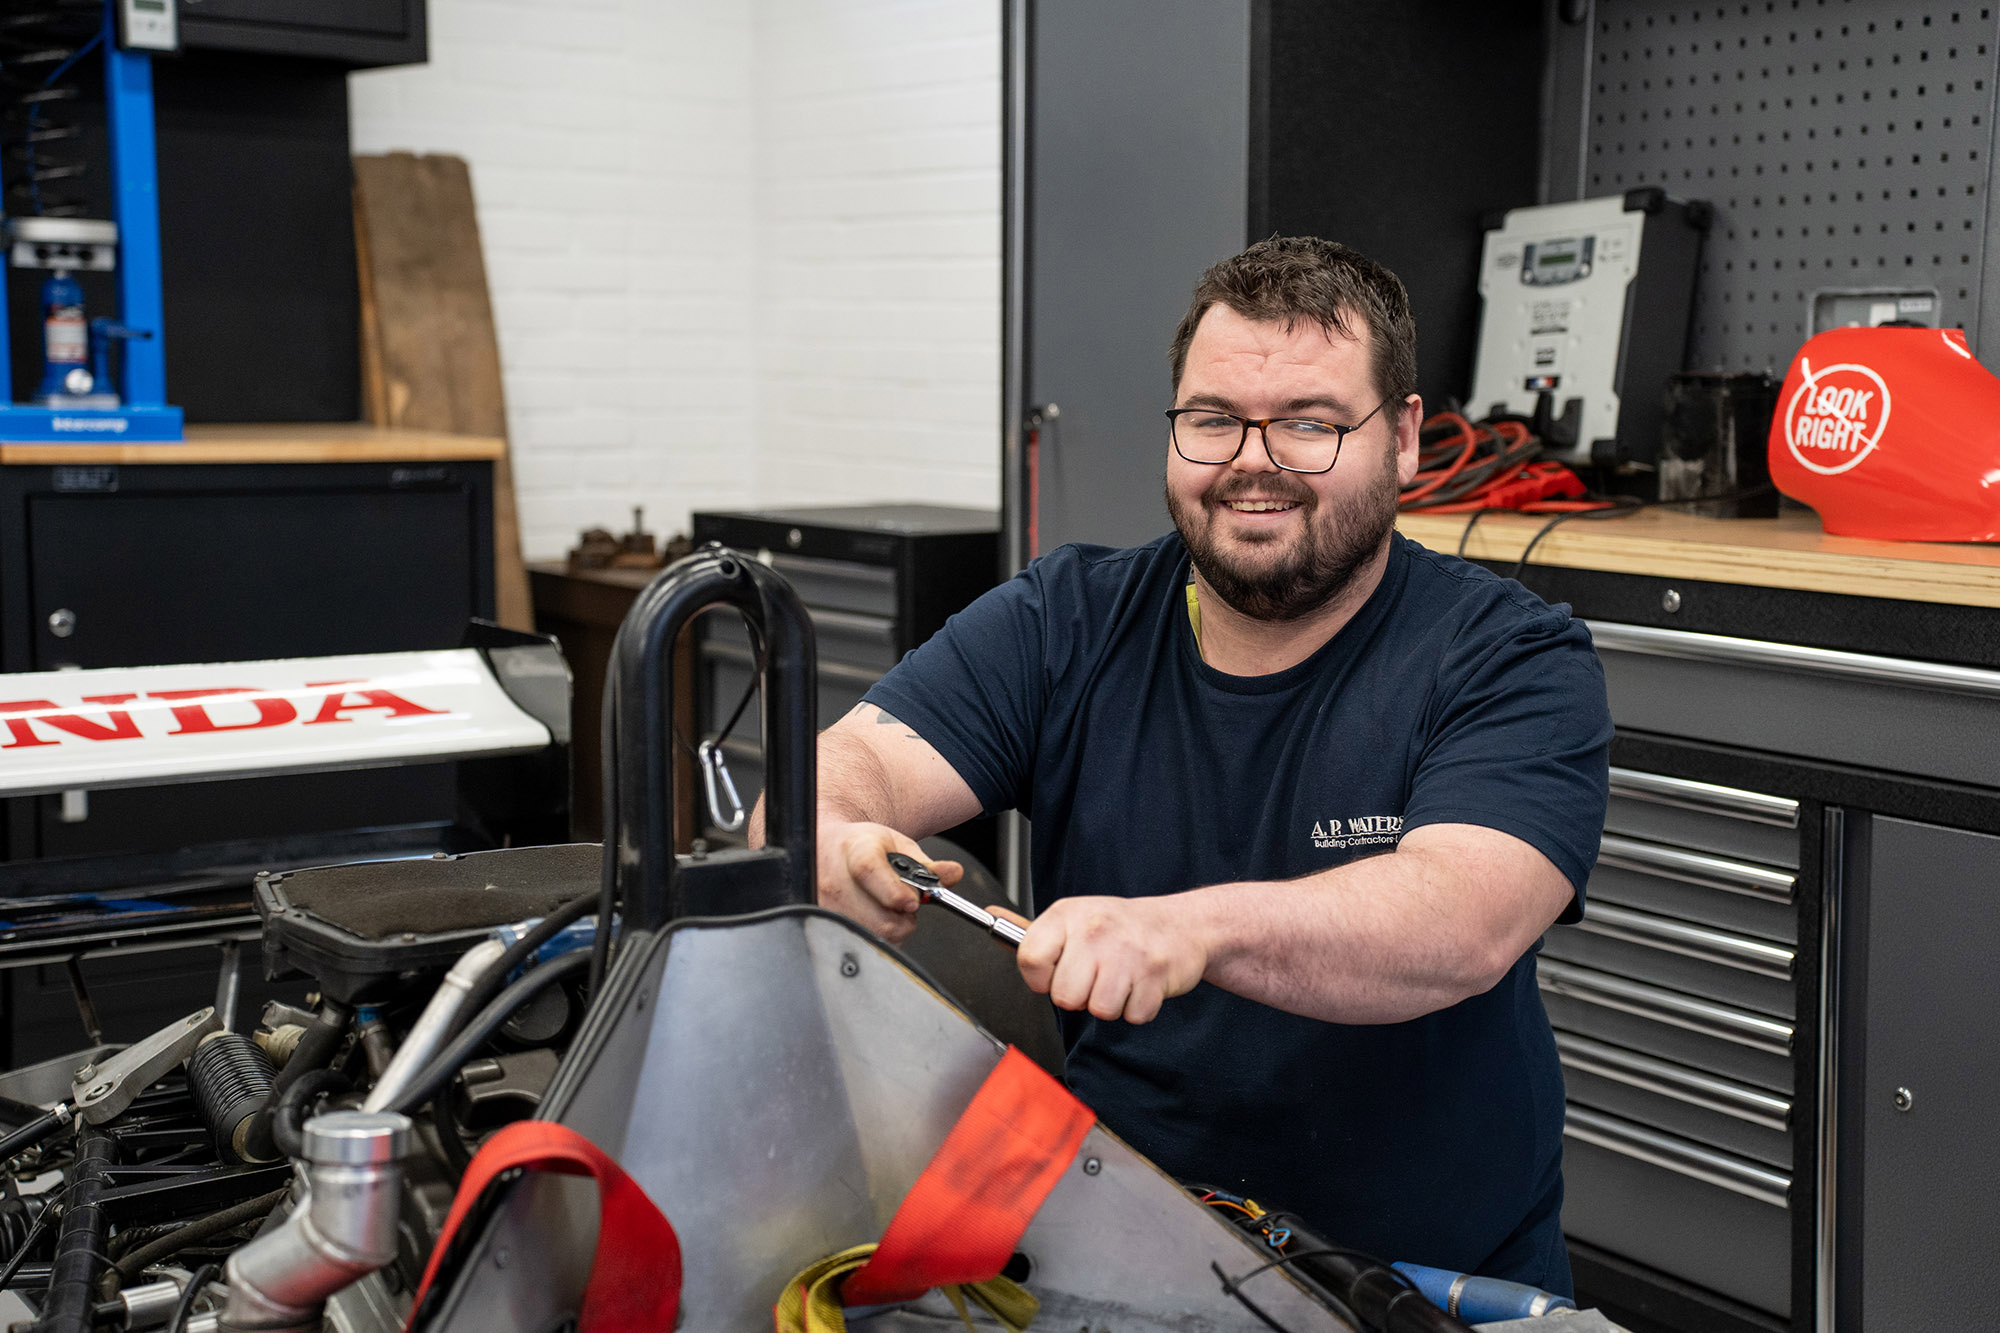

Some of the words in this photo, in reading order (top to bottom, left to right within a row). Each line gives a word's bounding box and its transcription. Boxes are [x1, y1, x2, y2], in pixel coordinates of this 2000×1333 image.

[1804, 385, 1874, 420] LOOK
[1795, 415, 1867, 453] RIGHT
[0, 681, 450, 748] NDA
[1314, 838, 1346, 849] Building
[1347, 834, 1394, 846] Contractors
